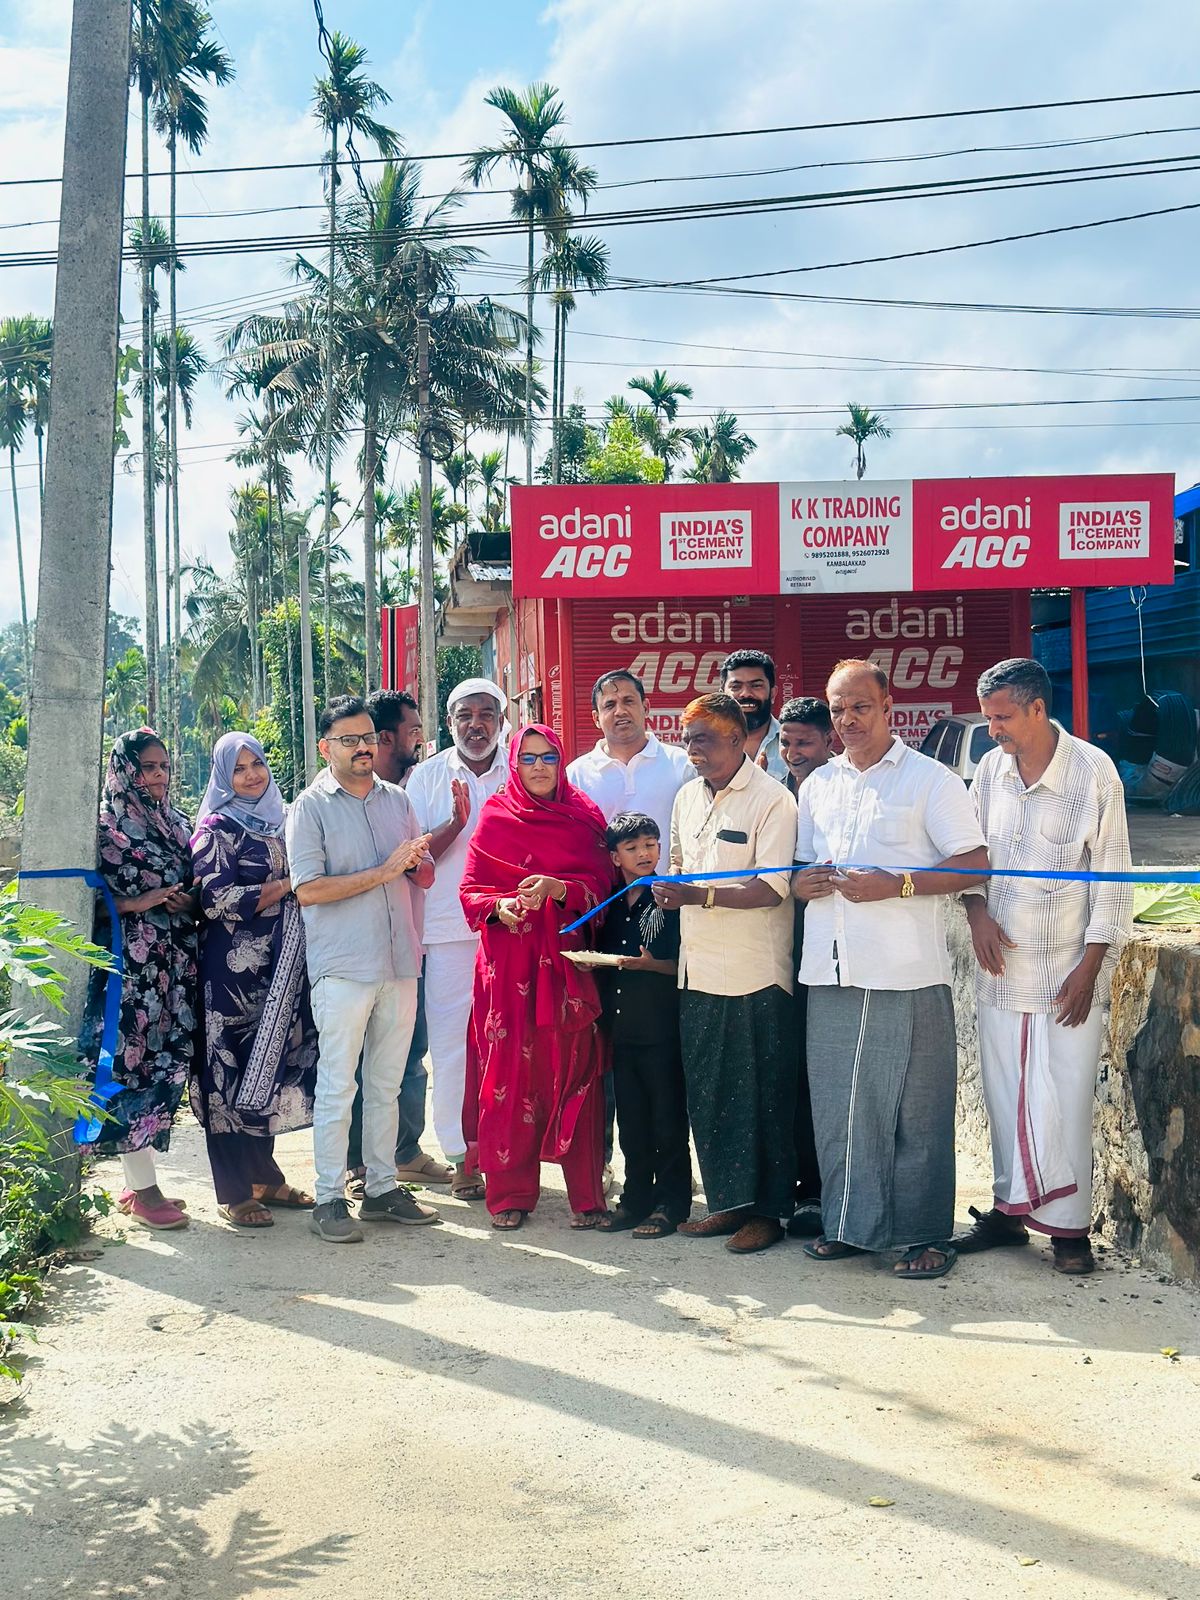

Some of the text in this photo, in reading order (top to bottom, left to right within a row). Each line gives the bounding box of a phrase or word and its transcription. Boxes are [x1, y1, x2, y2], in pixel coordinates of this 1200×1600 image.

[791, 496, 901, 519] K K TRADING
[940, 496, 1031, 531] adani
[1070, 509, 1142, 527] INDIA'S
[540, 505, 631, 539] adani
[671, 518, 744, 537] INDIA'S
[1085, 527, 1142, 539] CEMENT
[687, 536, 744, 549] CEMENT
[803, 525, 890, 548] COMPANY
[1076, 539, 1142, 551] COMPANY
[541, 544, 632, 578] ACC
[678, 549, 744, 561] COMPANY
[940, 535, 1031, 569] ACC
[610, 601, 731, 643] adani
[845, 596, 964, 640] adani
[867, 645, 964, 689] ACC
